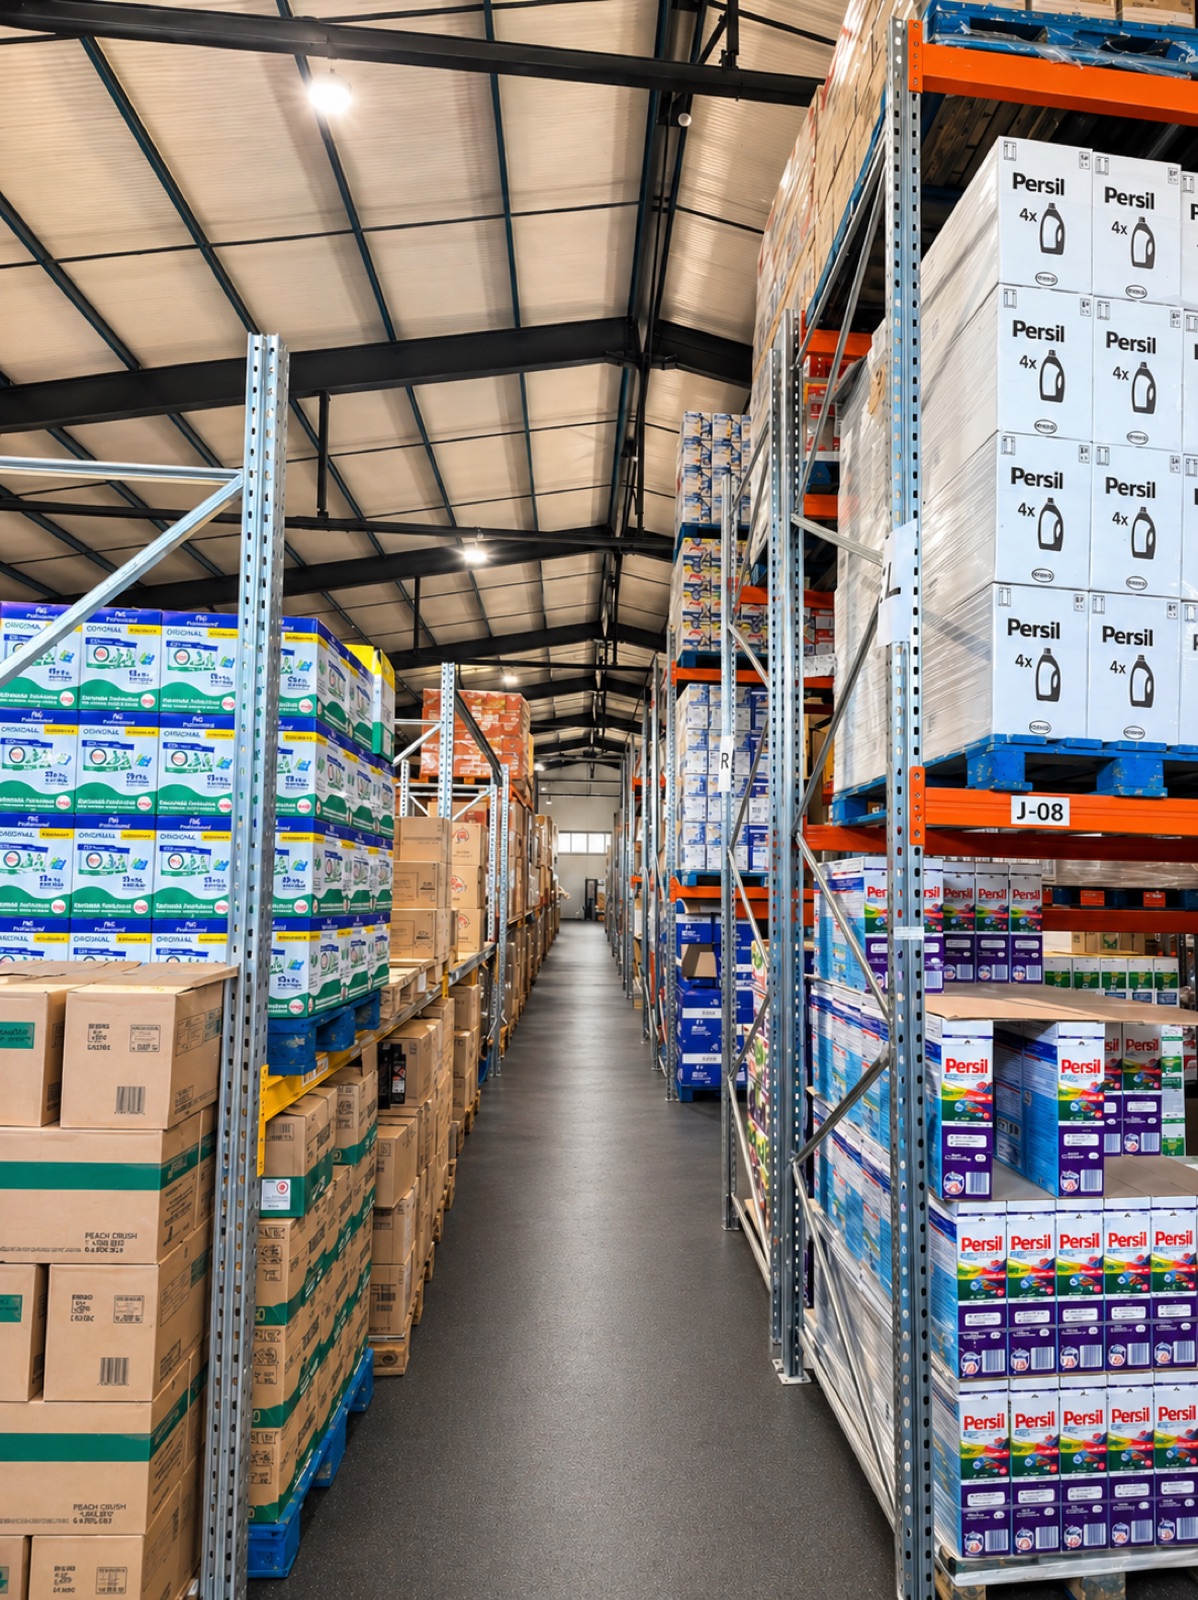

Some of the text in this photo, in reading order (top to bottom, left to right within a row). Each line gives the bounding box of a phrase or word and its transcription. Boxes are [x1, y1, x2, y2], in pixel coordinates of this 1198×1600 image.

[1012, 171, 1065, 196] Persil
[1104, 186, 1155, 210] Persil
[1019, 207, 1037, 223] 4x
[1111, 220, 1128, 235] 4x
[1012, 319, 1065, 343] Persil
[1106, 330, 1156, 355] Persil
[1019, 355, 1037, 370] 4x
[1112, 366, 1129, 381] 4x
[1010, 466, 1064, 490] Persil
[1105, 476, 1156, 499] Persil
[1017, 502, 1035, 518] 4x
[1112, 511, 1128, 526] 4x
[1007, 617, 1061, 640] Persil
[1102, 625, 1154, 647] Persil
[1015, 654, 1033, 668] 4x
[1109, 660, 1126, 674] 4x
[721, 752, 729, 769] R
[1016, 802, 1064, 822] J-08
[867, 886, 888, 898] Per
[924, 886, 940, 898] rsil
[943, 888, 973, 899] Persil
[978, 888, 1007, 899] Persil
[1013, 889, 1040, 900] Persil
[1105, 1039, 1119, 1052] sil
[1126, 1039, 1158, 1051] Persil
[945, 1058, 988, 1074] Persil
[1061, 1059, 1101, 1074] Persil
[960, 1236, 1002, 1252] Persil
[1010, 1234, 1052, 1250] Persil
[1060, 1232, 1100, 1248] Persil
[1108, 1232, 1146, 1248] Persil
[1154, 1230, 1192, 1246] Persil
[964, 1412, 1006, 1430] Persil
[1014, 1410, 1056, 1428] Persil
[1064, 1408, 1104, 1426] Persil
[1112, 1408, 1150, 1424] Persil
[1158, 1404, 1196, 1422] Persil
